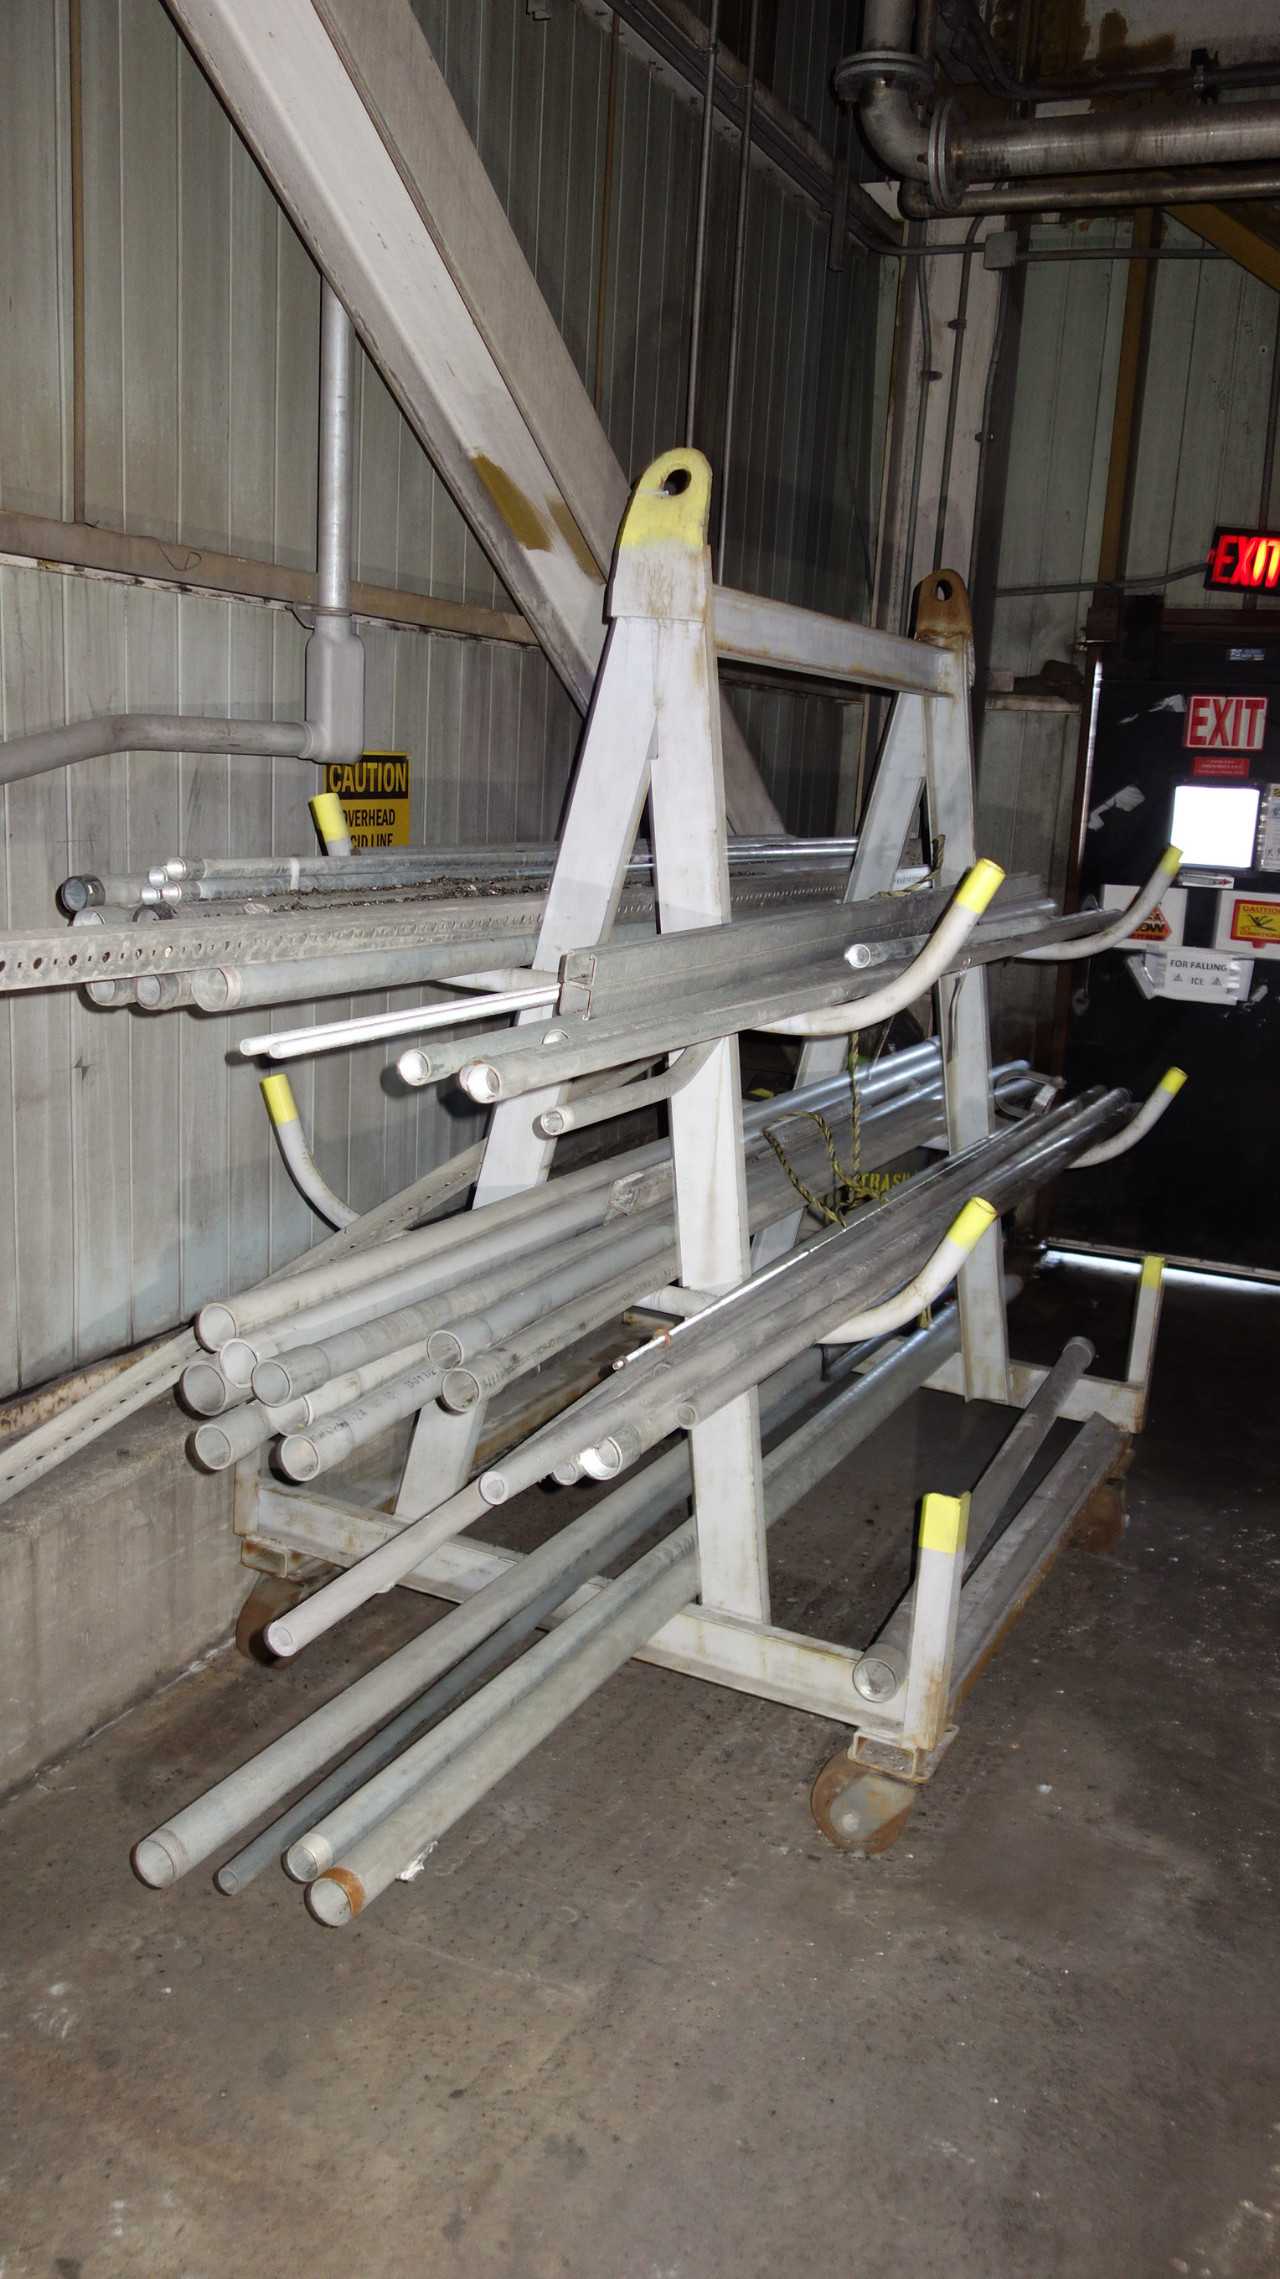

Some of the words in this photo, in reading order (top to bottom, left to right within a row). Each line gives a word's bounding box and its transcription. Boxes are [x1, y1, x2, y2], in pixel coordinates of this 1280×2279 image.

[1213, 534, 1280, 588] EXIT
[1189, 698, 1265, 748] EXIT
[329, 762, 406, 793] CAUTION
[351, 834, 368, 848] CID
[1170, 959, 1188, 969] FOR
[1190, 961, 1228, 972] FALLING
[1191, 977, 1204, 986] ICE
[860, 1171, 912, 1191] TRAS
